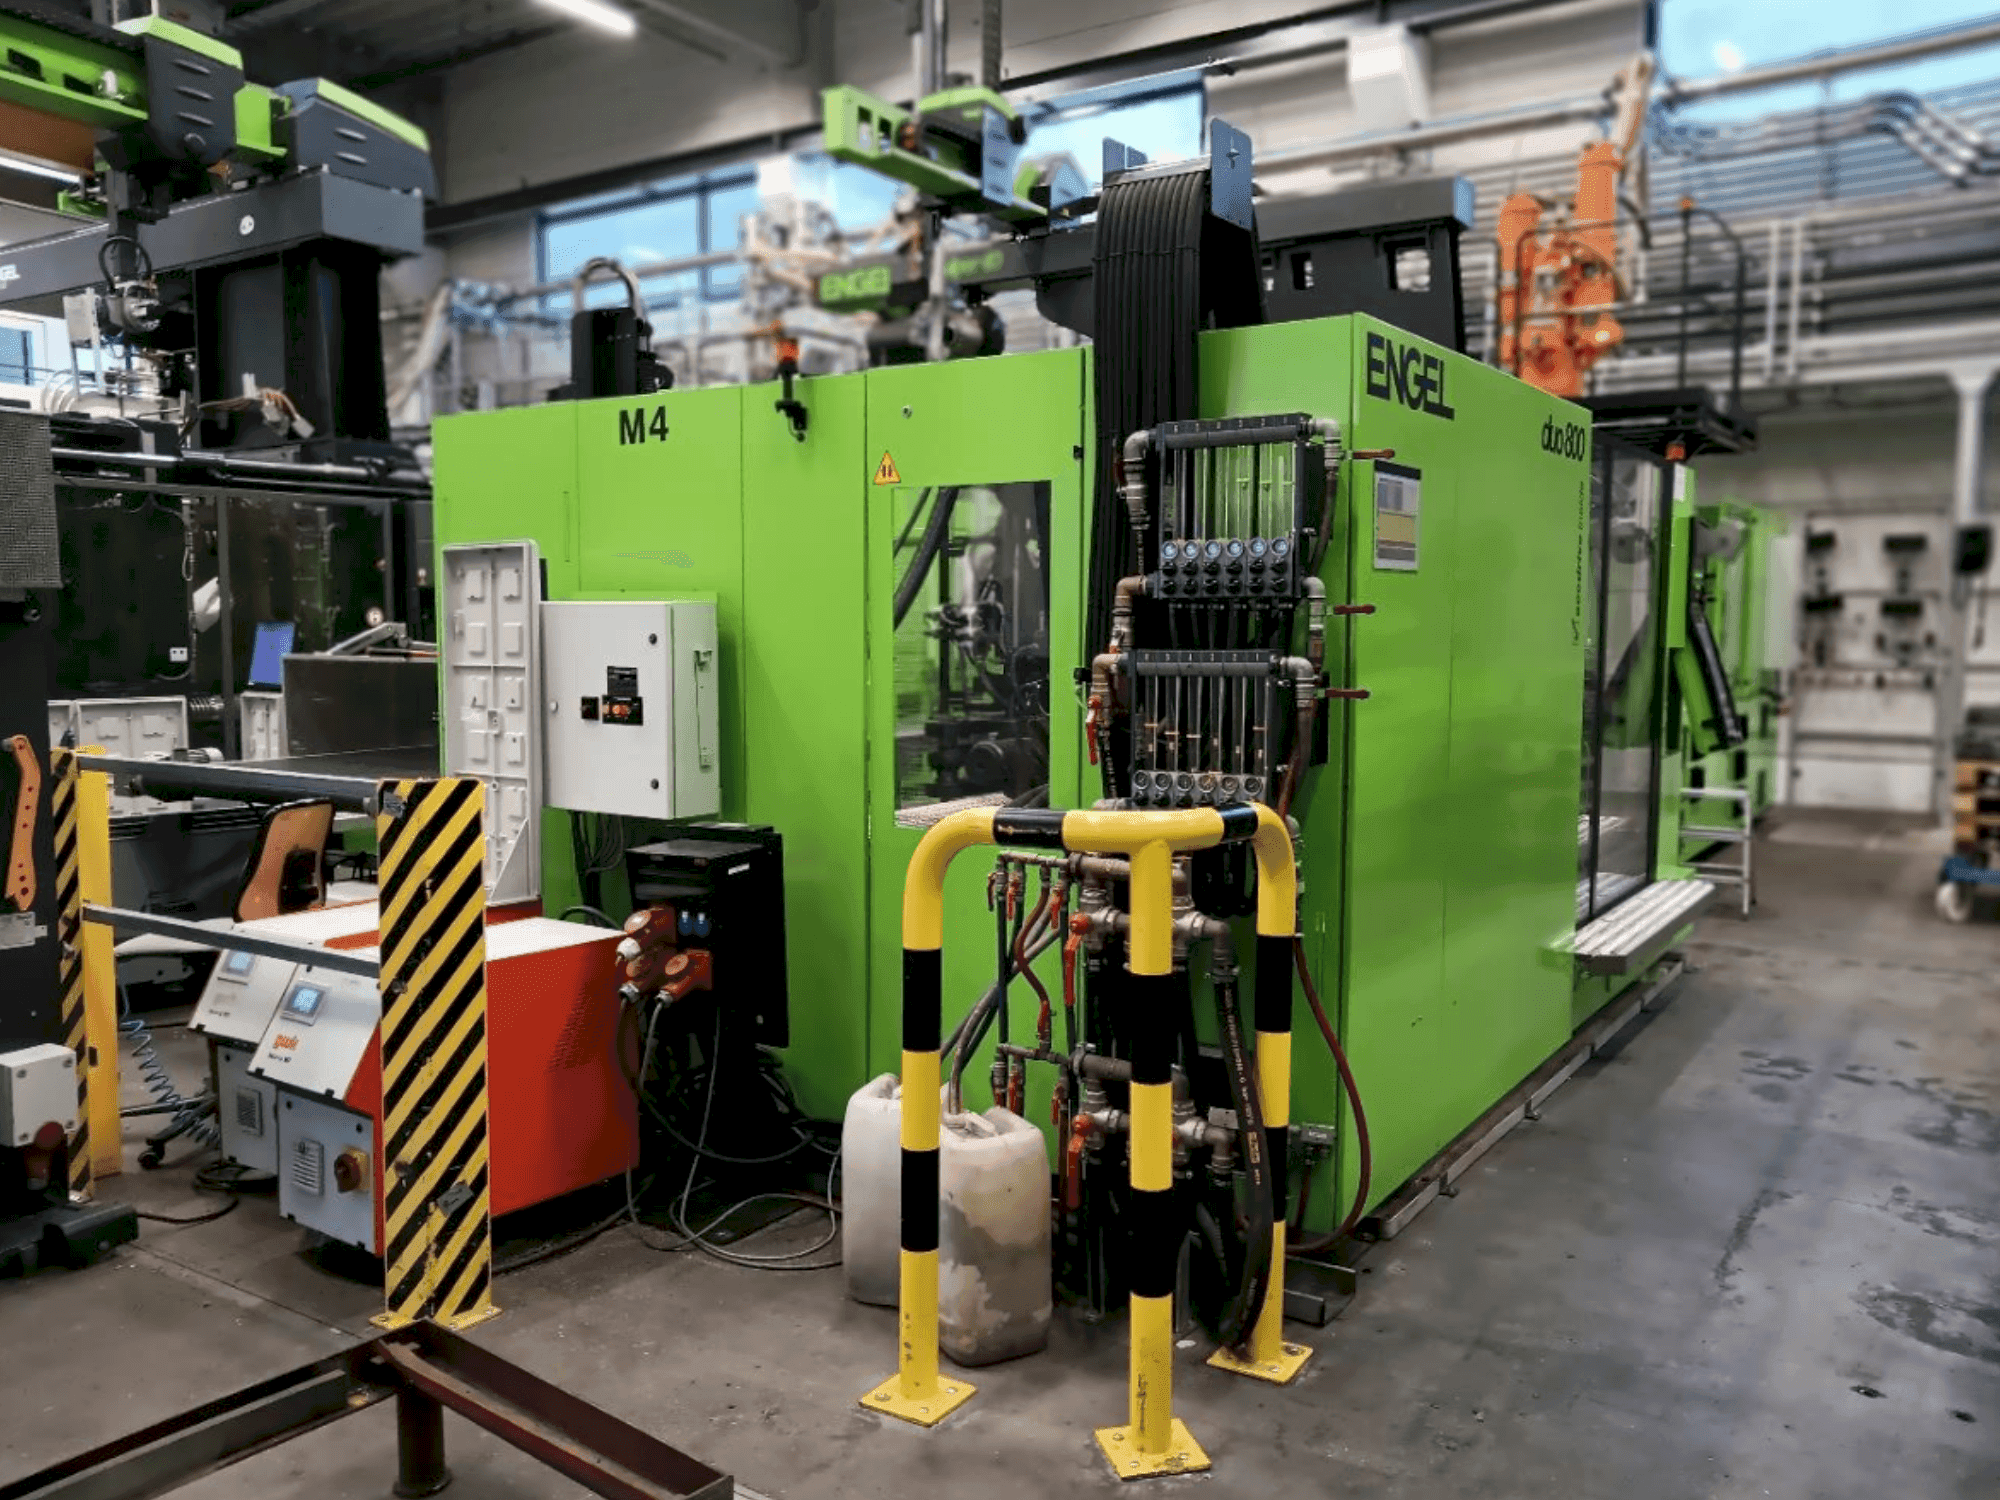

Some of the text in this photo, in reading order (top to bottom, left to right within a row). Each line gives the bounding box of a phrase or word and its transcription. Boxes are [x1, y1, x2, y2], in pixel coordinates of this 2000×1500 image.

[1367, 331, 1455, 420] ENGEL
[619, 405, 669, 445] M4
[1541, 414, 1585, 461] duo 800
